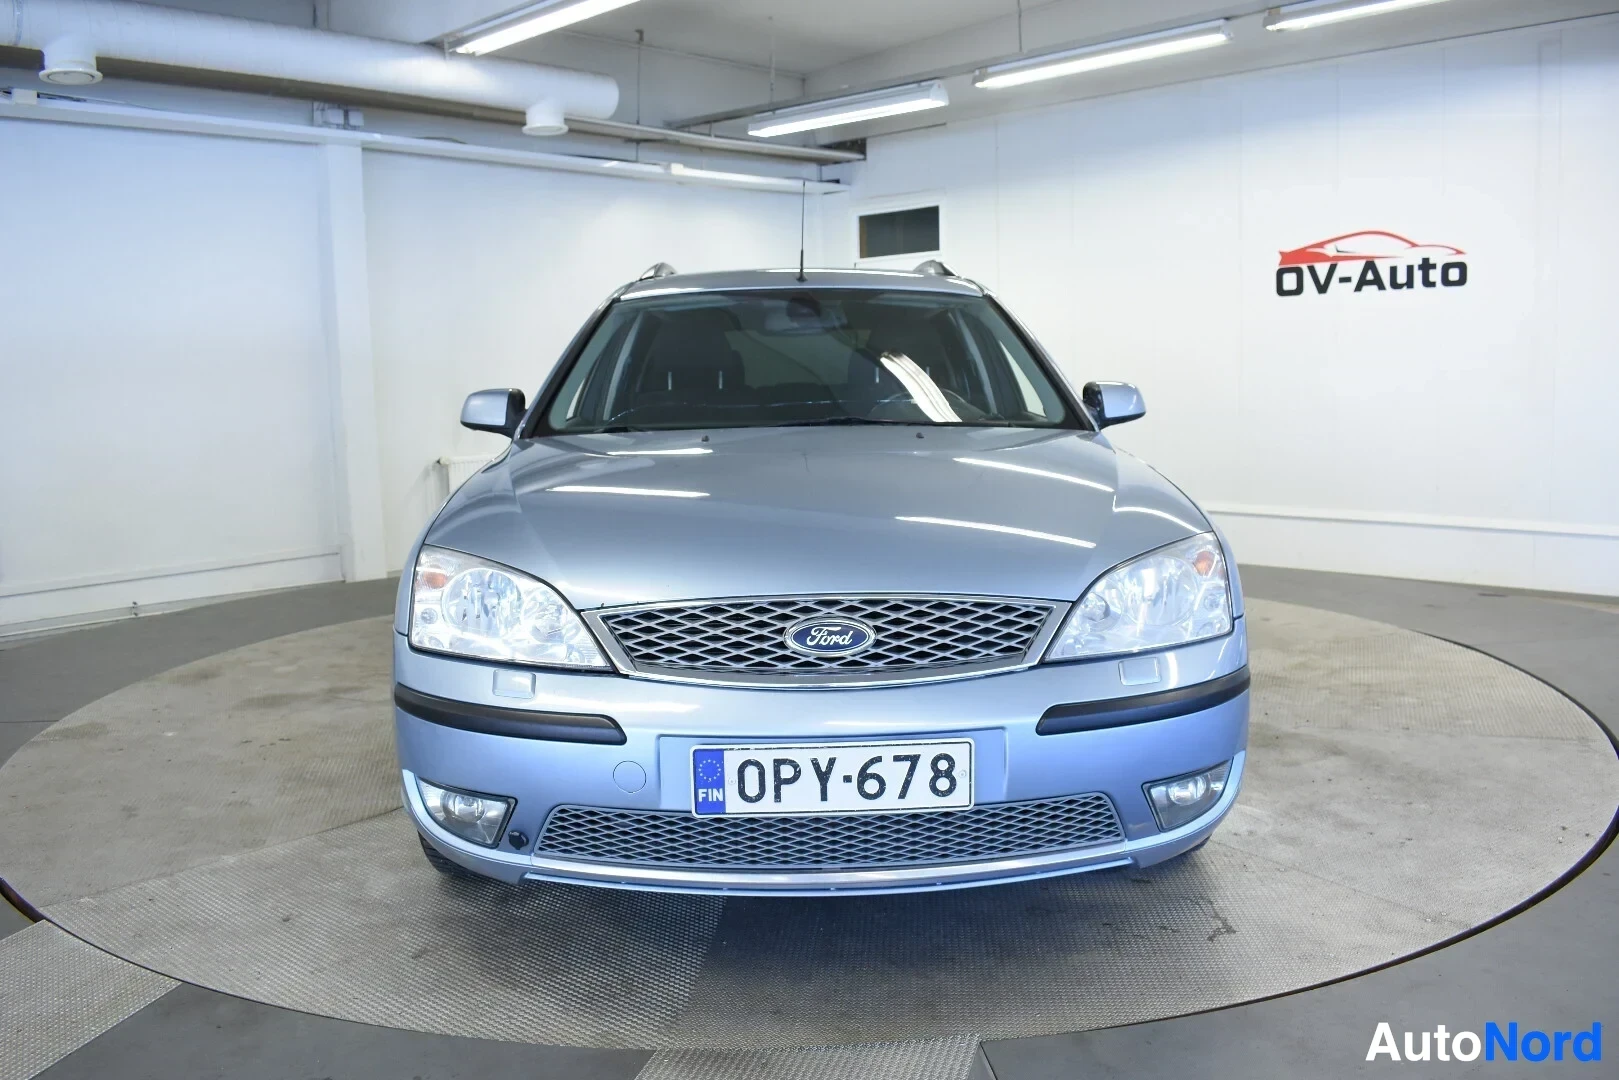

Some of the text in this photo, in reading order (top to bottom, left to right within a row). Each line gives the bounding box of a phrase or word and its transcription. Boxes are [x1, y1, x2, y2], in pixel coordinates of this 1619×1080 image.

[1275, 257, 1468, 297] OV-Auto
[806, 626, 854, 646] Ford
[737, 752, 957, 804] OPY-678
[698, 787, 724, 803] FIN
